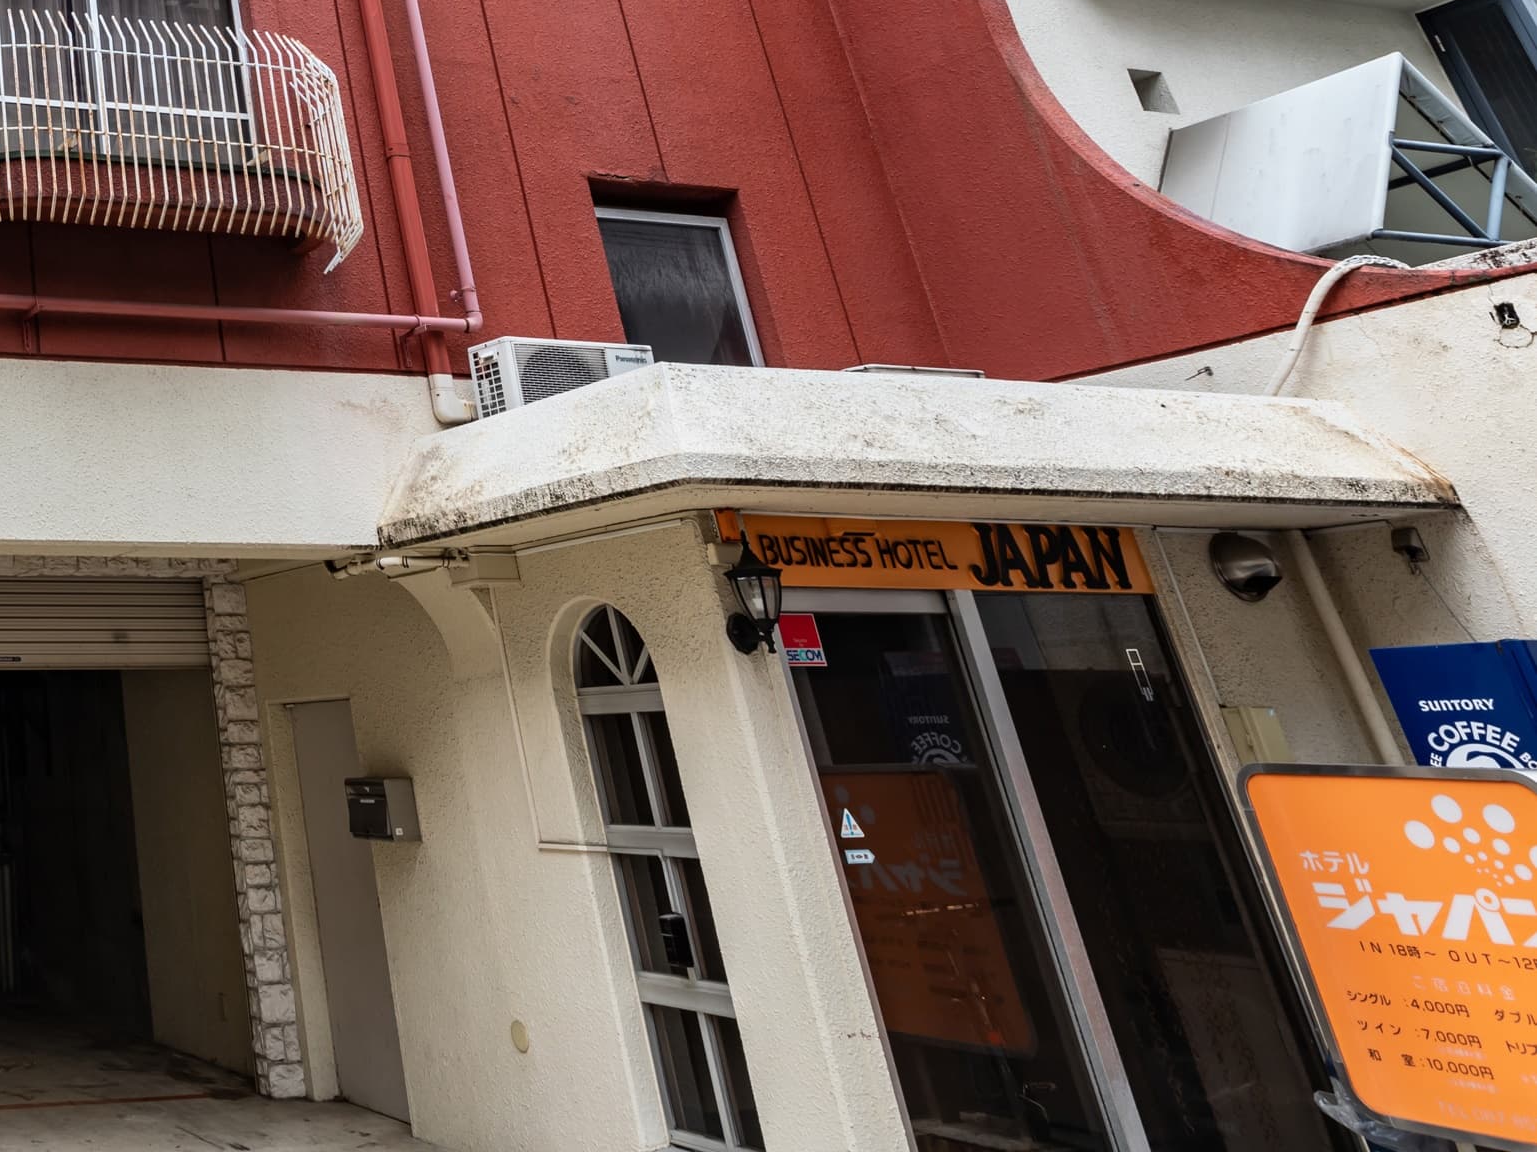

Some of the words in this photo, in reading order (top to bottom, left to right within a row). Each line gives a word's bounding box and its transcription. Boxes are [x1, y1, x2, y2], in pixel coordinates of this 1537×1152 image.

[758, 534, 873, 568] BUSINESS
[875, 539, 959, 570] HOTEL
[970, 524, 1132, 590] JAPAN
[786, 649, 823, 661] SECOM
[1427, 720, 1520, 754] COFFEE
[1299, 850, 1370, 875] ホテル
[1347, 990, 1391, 1006] シングル
[1357, 1019, 1401, 1035] ツイン
